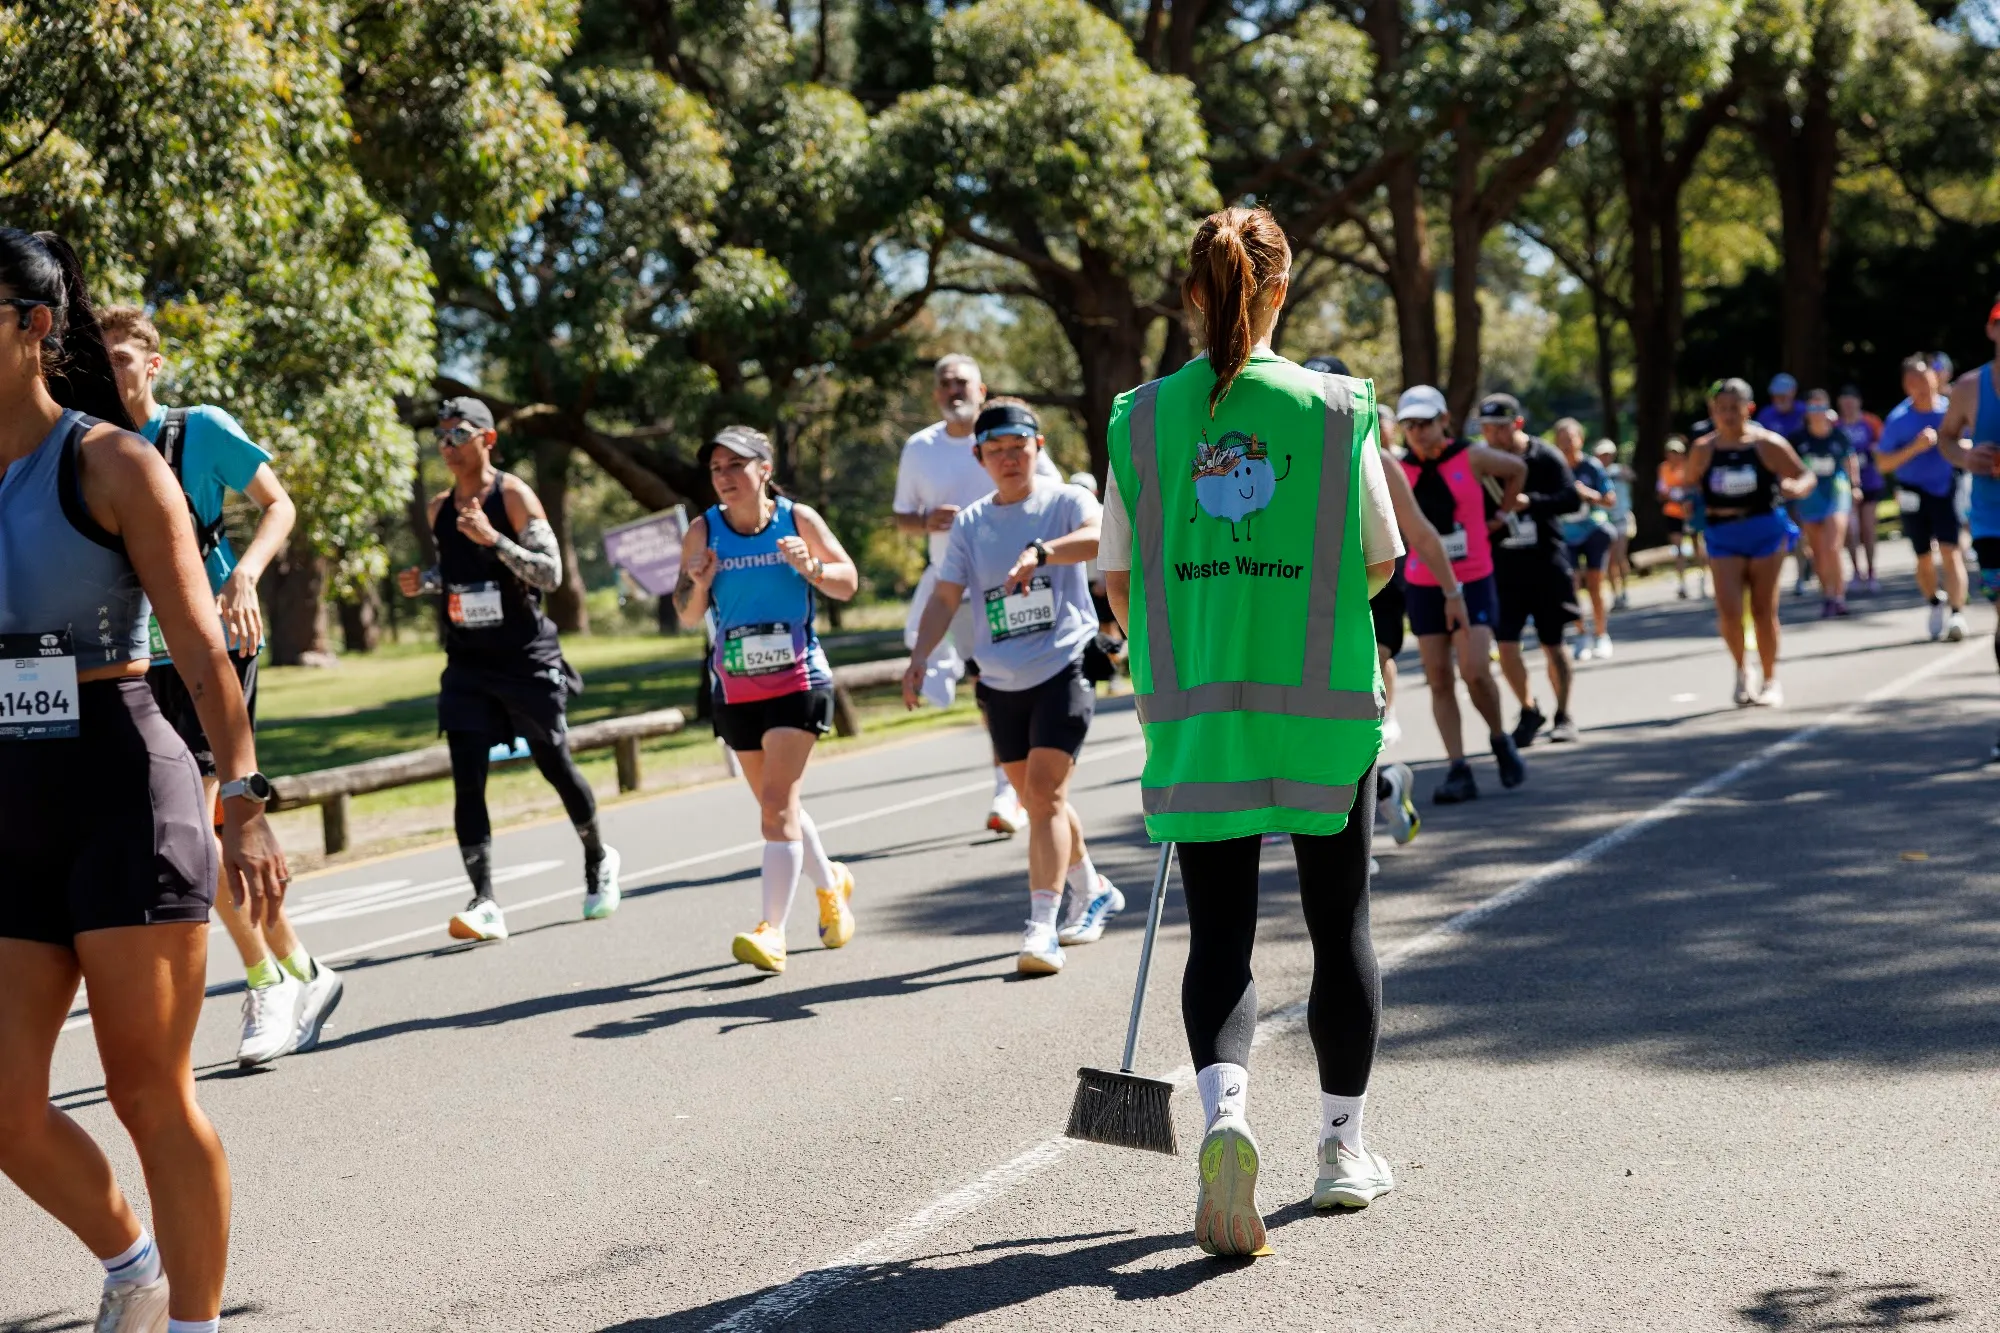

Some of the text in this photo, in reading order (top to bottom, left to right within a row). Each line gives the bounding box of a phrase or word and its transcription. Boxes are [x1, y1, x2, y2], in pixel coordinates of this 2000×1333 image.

[1174, 555, 1304, 581] Waste Warrior
[1009, 605, 1051, 626] 50798
[39, 648, 64, 656] TATA
[747, 648, 790, 665] 52475
